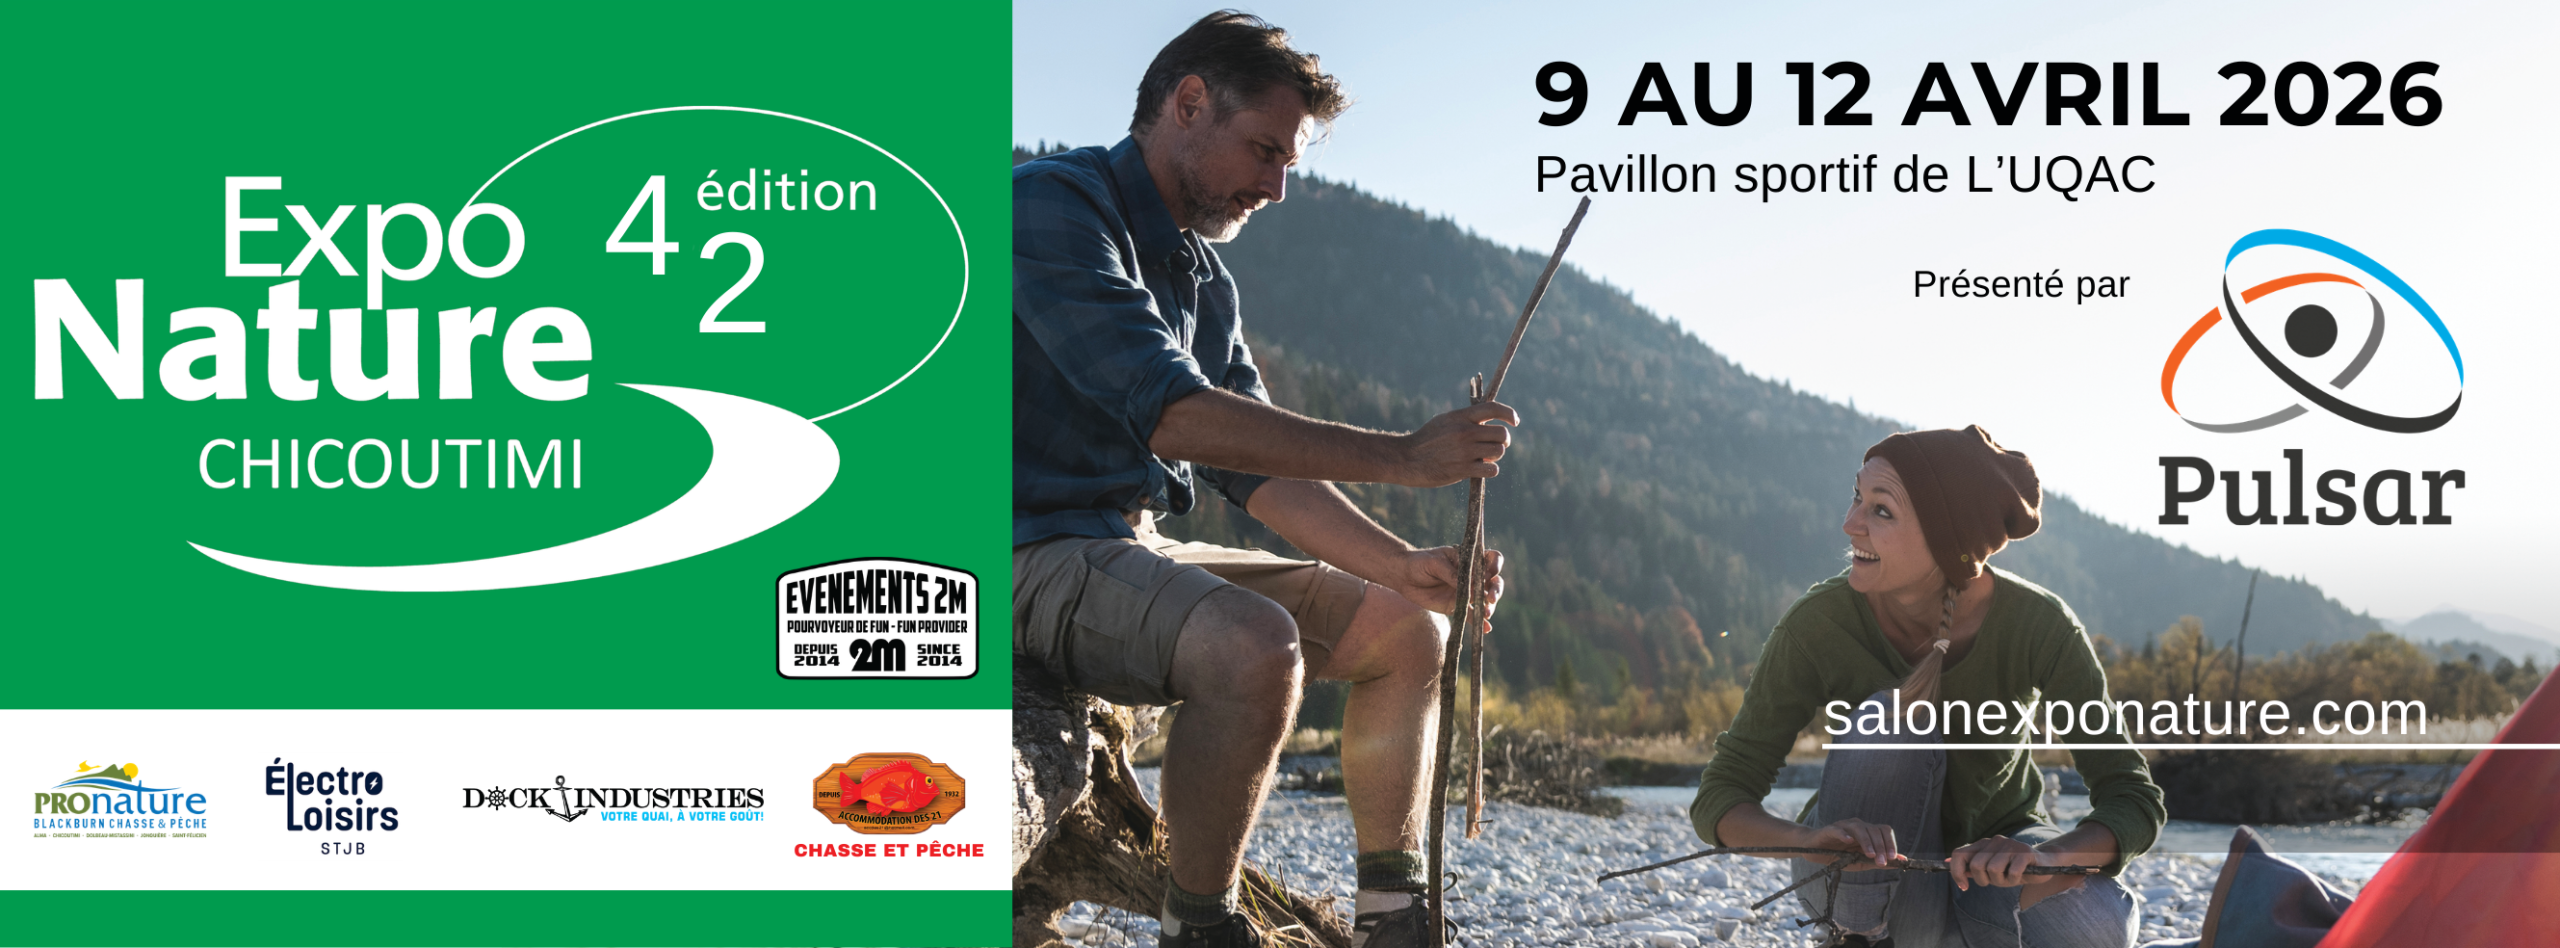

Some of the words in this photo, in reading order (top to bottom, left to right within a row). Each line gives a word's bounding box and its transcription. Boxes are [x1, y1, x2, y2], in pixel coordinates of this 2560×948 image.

[1536, 61, 1588, 126] 9
[1618, 62, 1752, 126] AU
[1786, 61, 1872, 126] 12
[1901, 62, 2189, 126] AVRIL
[2218, 61, 2442, 126] 2026
[696, 168, 877, 211] édition
[1537, 154, 1716, 193] Pavillon
[1734, 154, 1877, 203] sportif
[1893, 154, 1949, 193] de
[224, 176, 526, 310] Expo
[1915, 269, 2064, 298] Présenté
[2077, 276, 2131, 306] par
[33, 277, 593, 402] Nature
[200, 438, 582, 490] CHICOUTIMI
[2158, 448, 2466, 526] Pulsar
[786, 569, 929, 614] EVENEMENTS
[934, 575, 967, 614] 2M
[787, 620, 854, 633] POURVOYEUR
[856, 620, 868, 633] DE
[870, 620, 889, 633] FUN
[897, 620, 916, 633] FUN
[918, 620, 968, 633] PROVIDER
[794, 644, 838, 655] DEPUIS
[794, 656, 841, 667] 2014
[849, 638, 906, 672] 2M
[917, 644, 961, 655] SINCE
[917, 656, 963, 667] 2014
[1823, 690, 2429, 745] salonexponature.com
[265, 757, 384, 796] Électro
[287, 797, 400, 832] Loisirs
[574, 787, 765, 809] INDUSTRIES
[34, 819, 105, 829] BLACKBURN
[110, 819, 155, 829] CHASSE
[600, 811, 638, 822] VOTRE
[642, 811, 673, 823] QUAI,
[676, 809, 686, 822] À
[689, 811, 727, 822] VOTRE
[729, 808, 764, 822] GOÛT!
[838, 811, 912, 825] ACCOMMODATION
[914, 813, 930, 824] DES
[931, 811, 942, 820] 21
[321, 843, 365, 855] STJB
[794, 843, 877, 857] CHASSE
[884, 843, 910, 857] ET
[917, 840, 984, 857] PÊCHE
